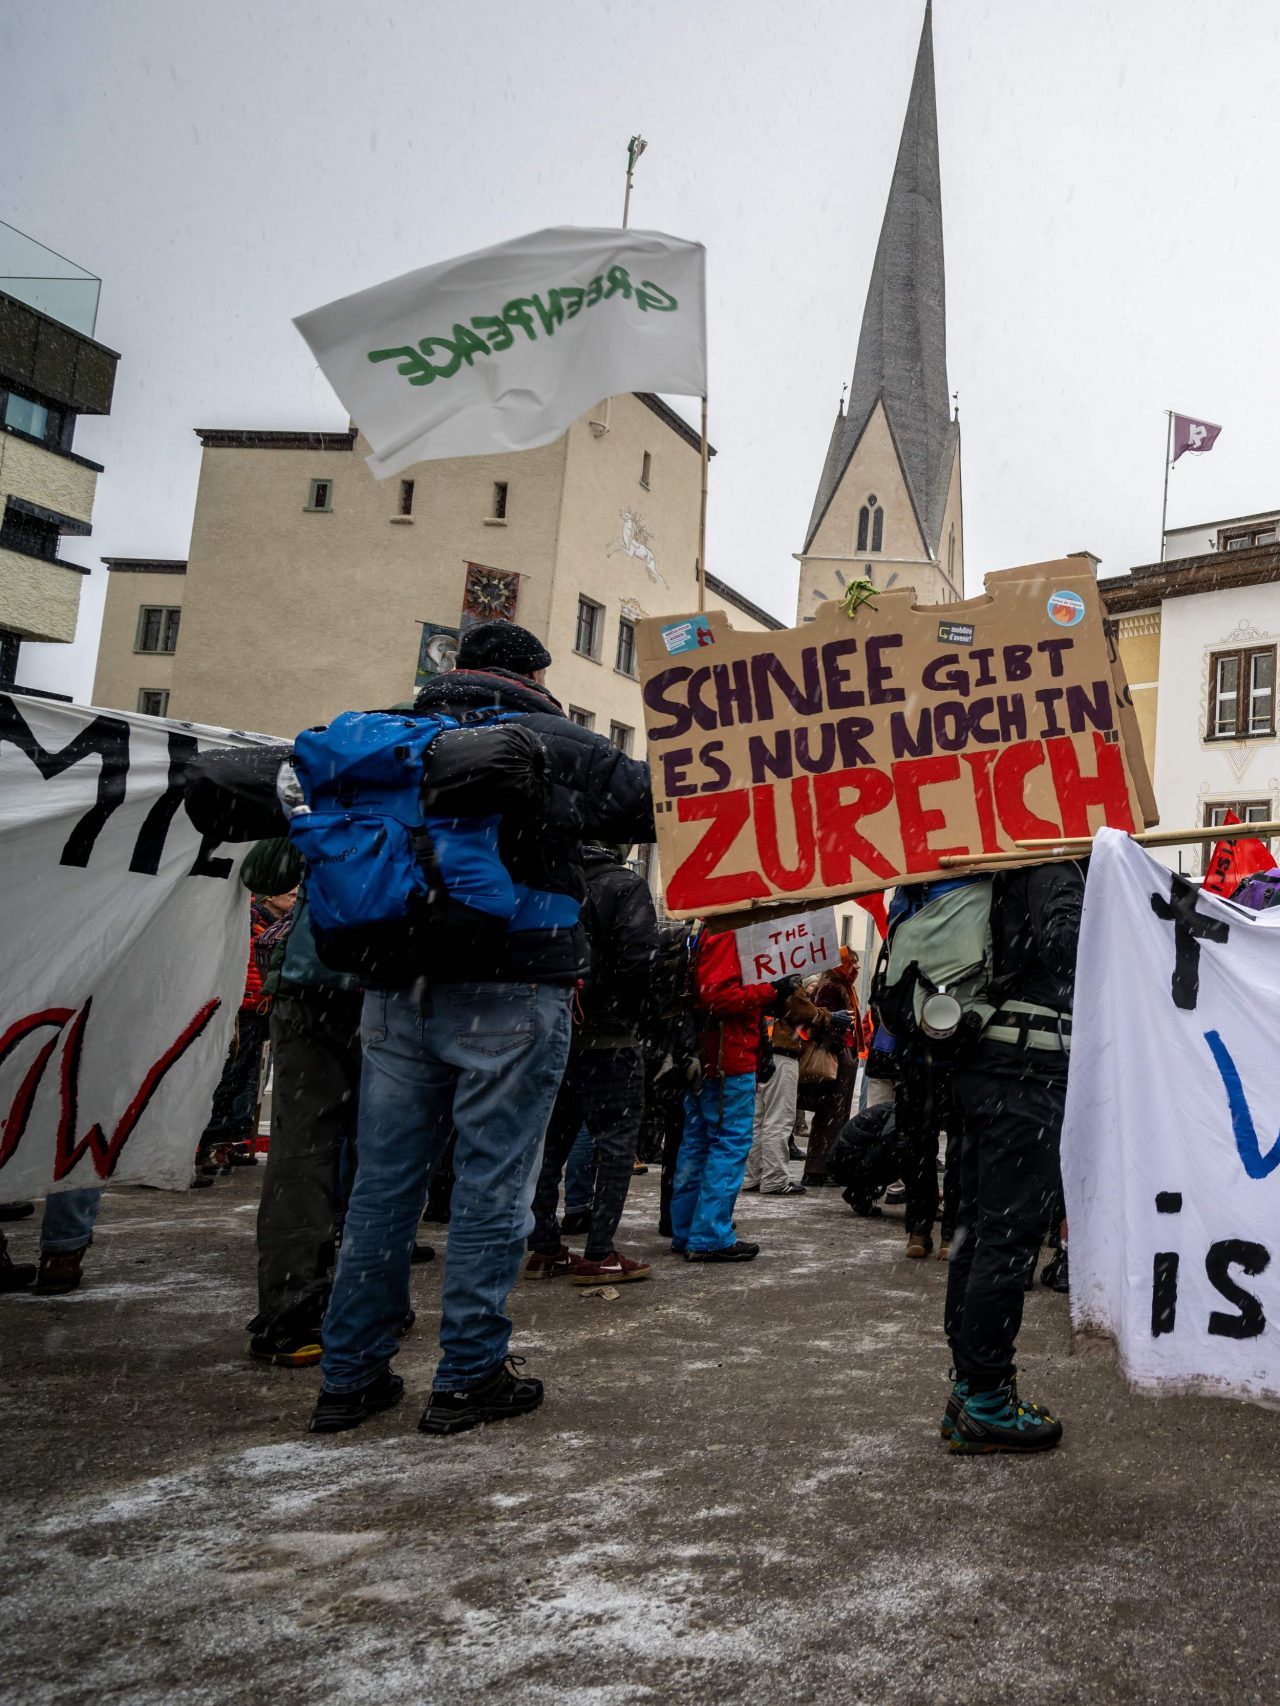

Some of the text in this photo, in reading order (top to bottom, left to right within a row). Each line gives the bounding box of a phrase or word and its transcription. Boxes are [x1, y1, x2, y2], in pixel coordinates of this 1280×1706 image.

[643, 634, 905, 740] SCHNEE
[922, 638, 1074, 697] GIBT
[659, 740, 731, 797] ES
[748, 716, 875, 784] NUR
[891, 693, 1028, 759] NOCH
[1035, 680, 1114, 738] IN
[753, 937, 827, 980] RICH
[769, 923, 809, 945] THE
